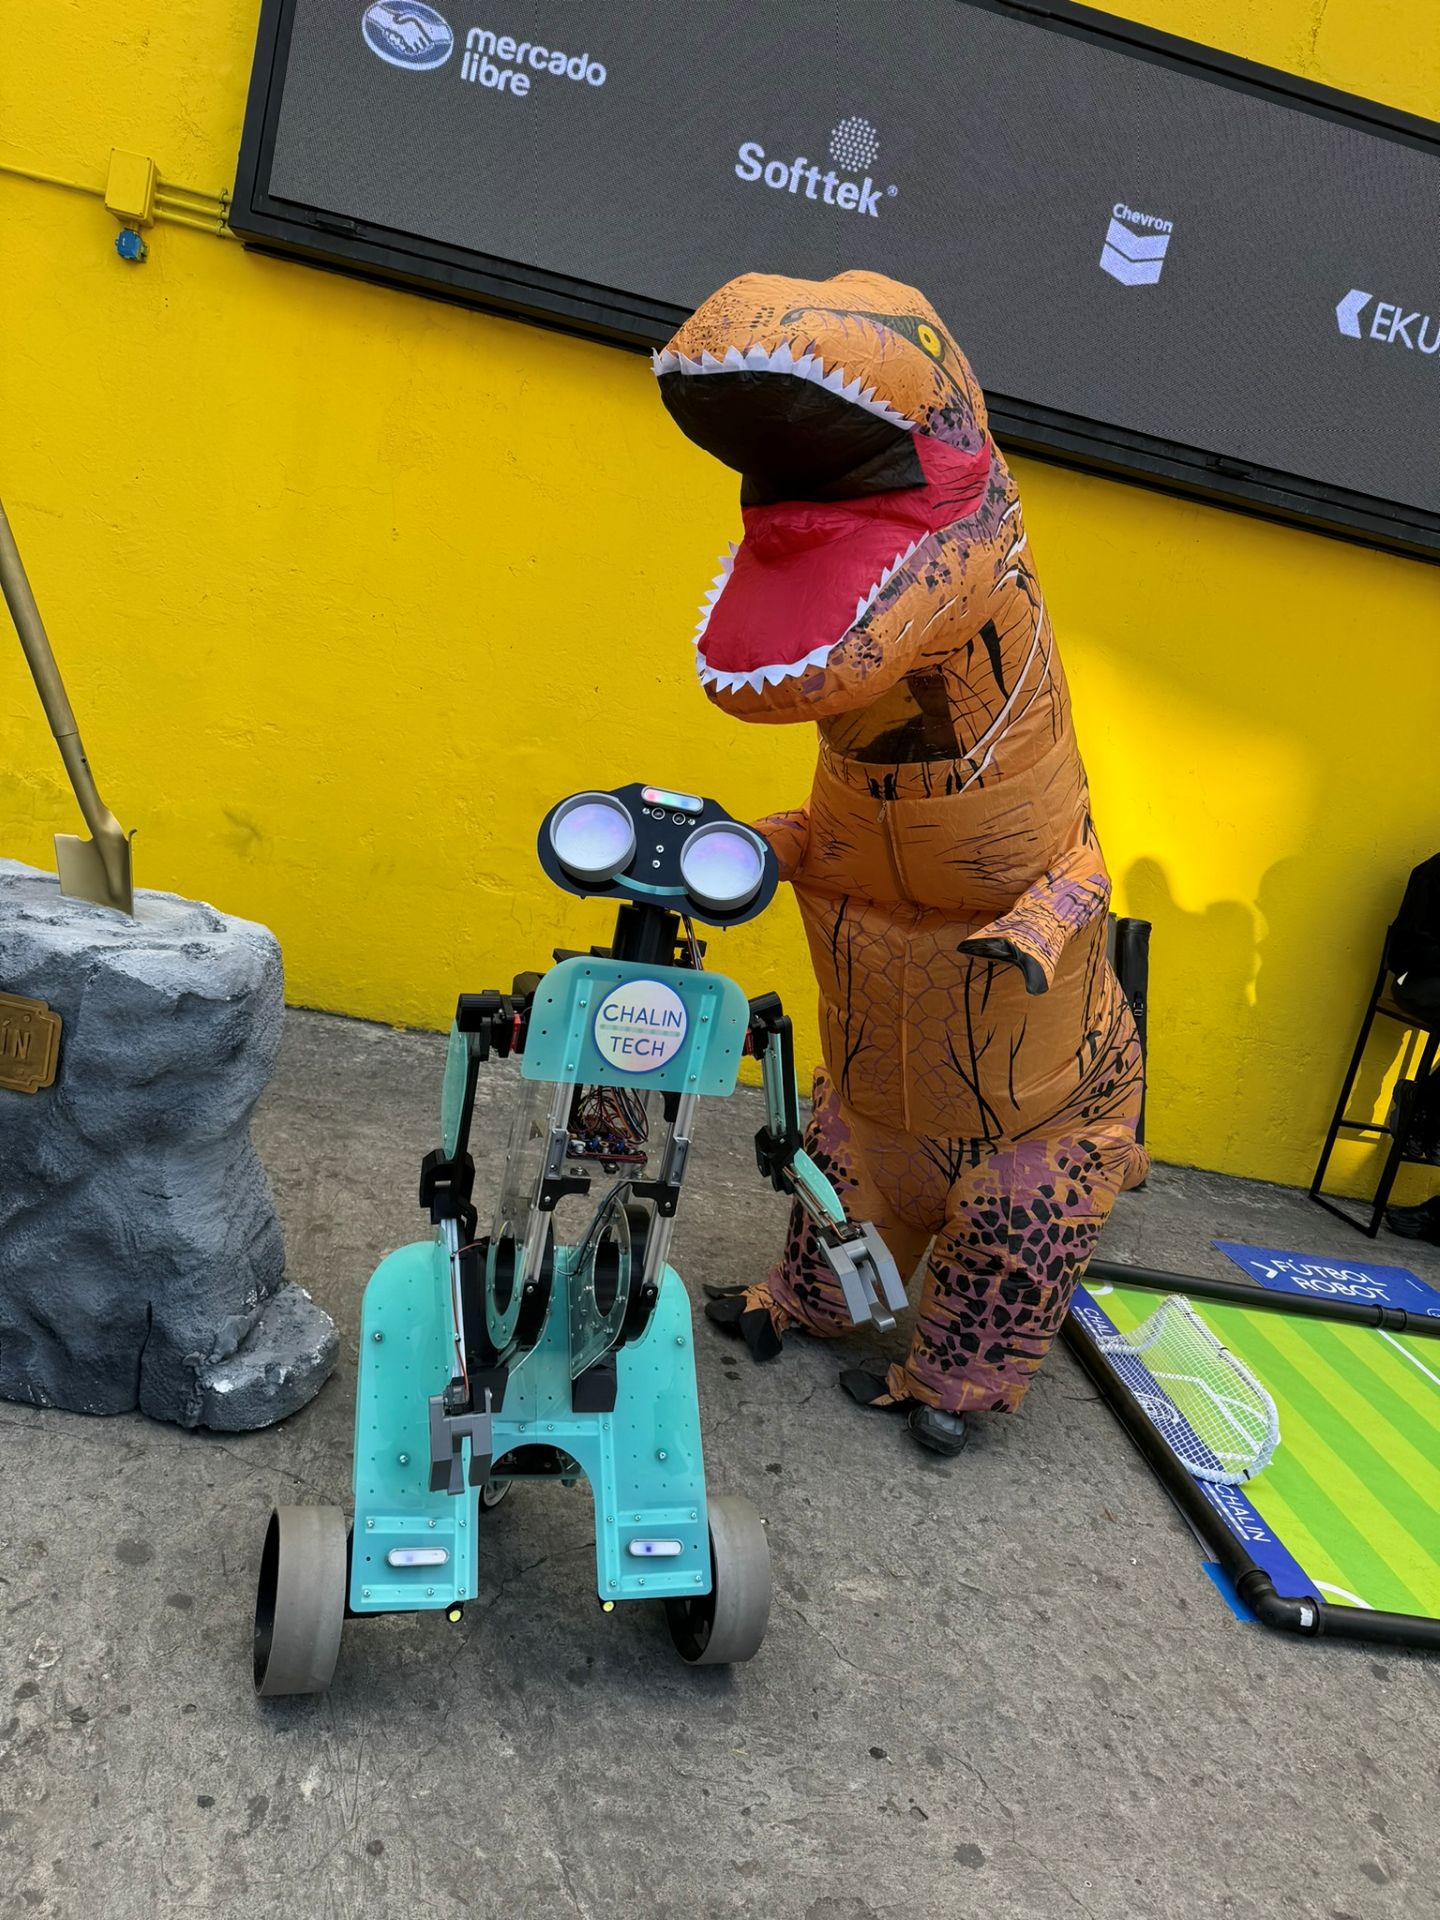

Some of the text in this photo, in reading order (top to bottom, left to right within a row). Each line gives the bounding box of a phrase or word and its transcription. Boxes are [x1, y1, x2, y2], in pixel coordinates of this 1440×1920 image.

[466, 27, 607, 87] mercado
[460, 51, 531, 96] libre
[1112, 203, 1174, 234] Chevron
[1369, 302, 1440, 355] EKU
[603, 1004, 682, 1028] CHALIN
[610, 1036, 664, 1057] TECH
[1291, 1276, 1391, 1301] ROBOT
[1083, 1307, 1113, 1336] CHAL
[1214, 1484, 1272, 1542] CHALIN
